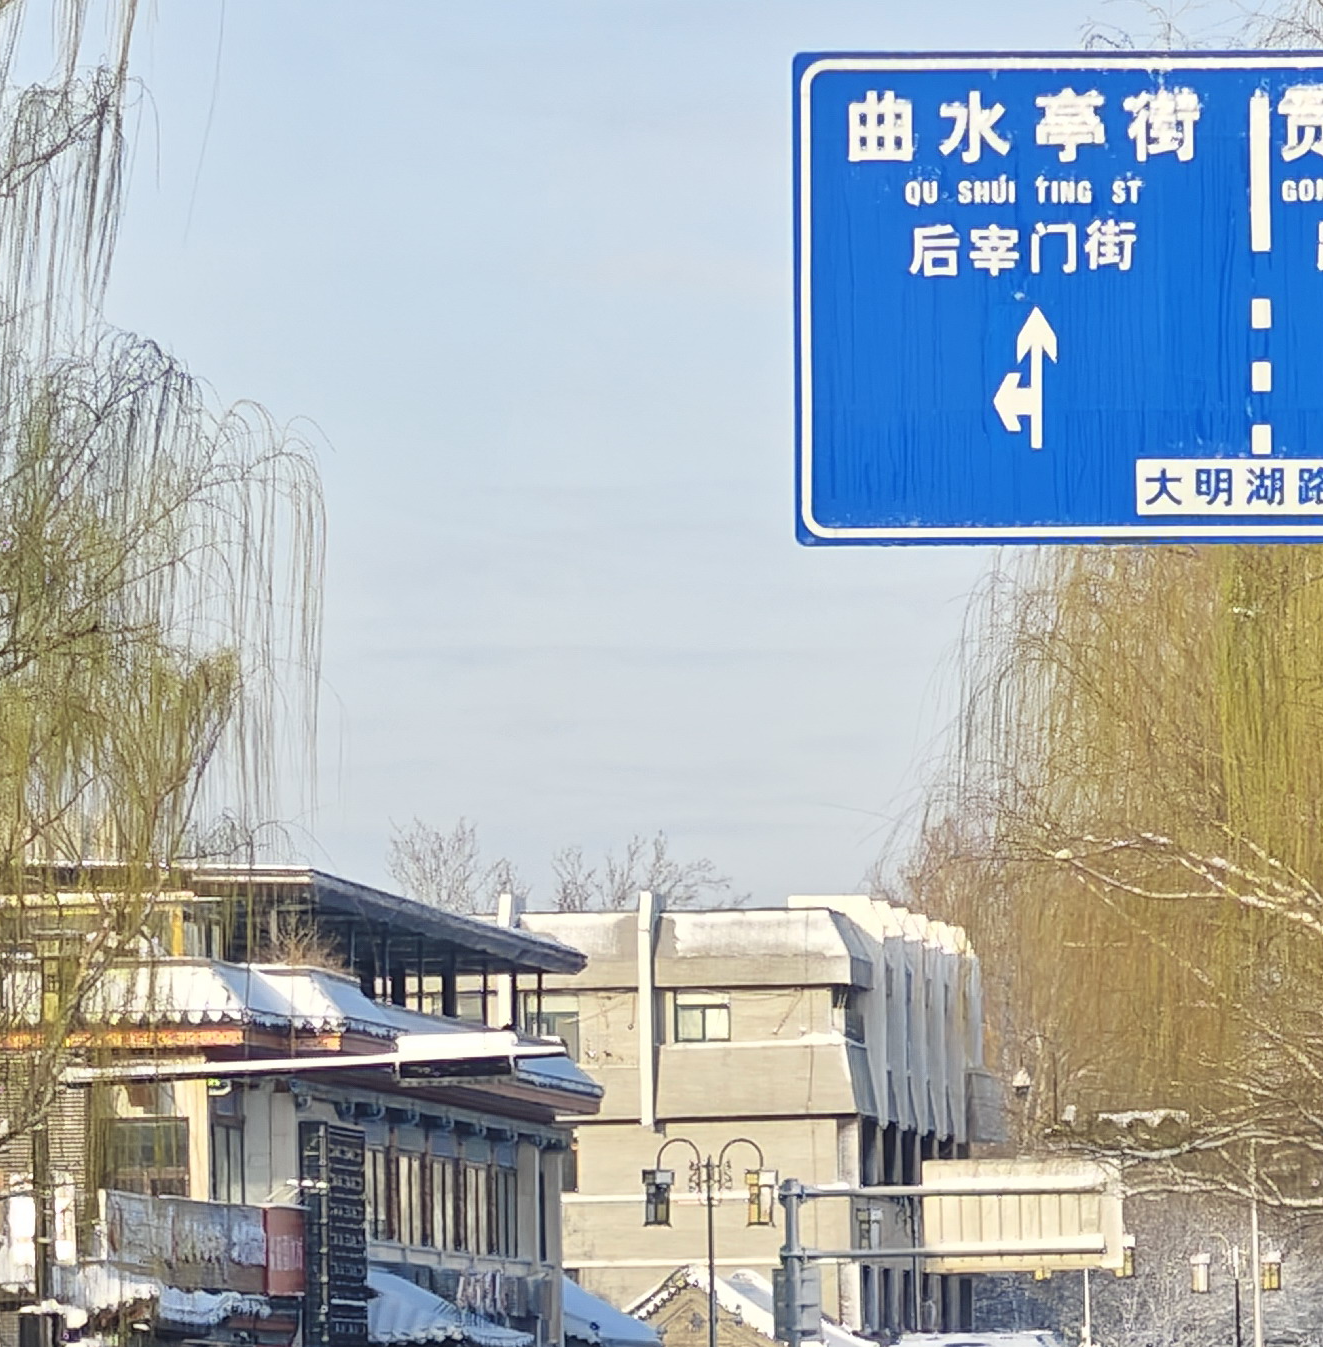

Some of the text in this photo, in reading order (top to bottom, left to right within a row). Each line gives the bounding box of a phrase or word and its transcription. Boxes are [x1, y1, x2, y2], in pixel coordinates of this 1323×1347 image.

[848, 86, 1201, 163] 曲水亭街
[905, 177, 1143, 206] QU SHUI TING ST
[909, 220, 1137, 277] 后宰门街
